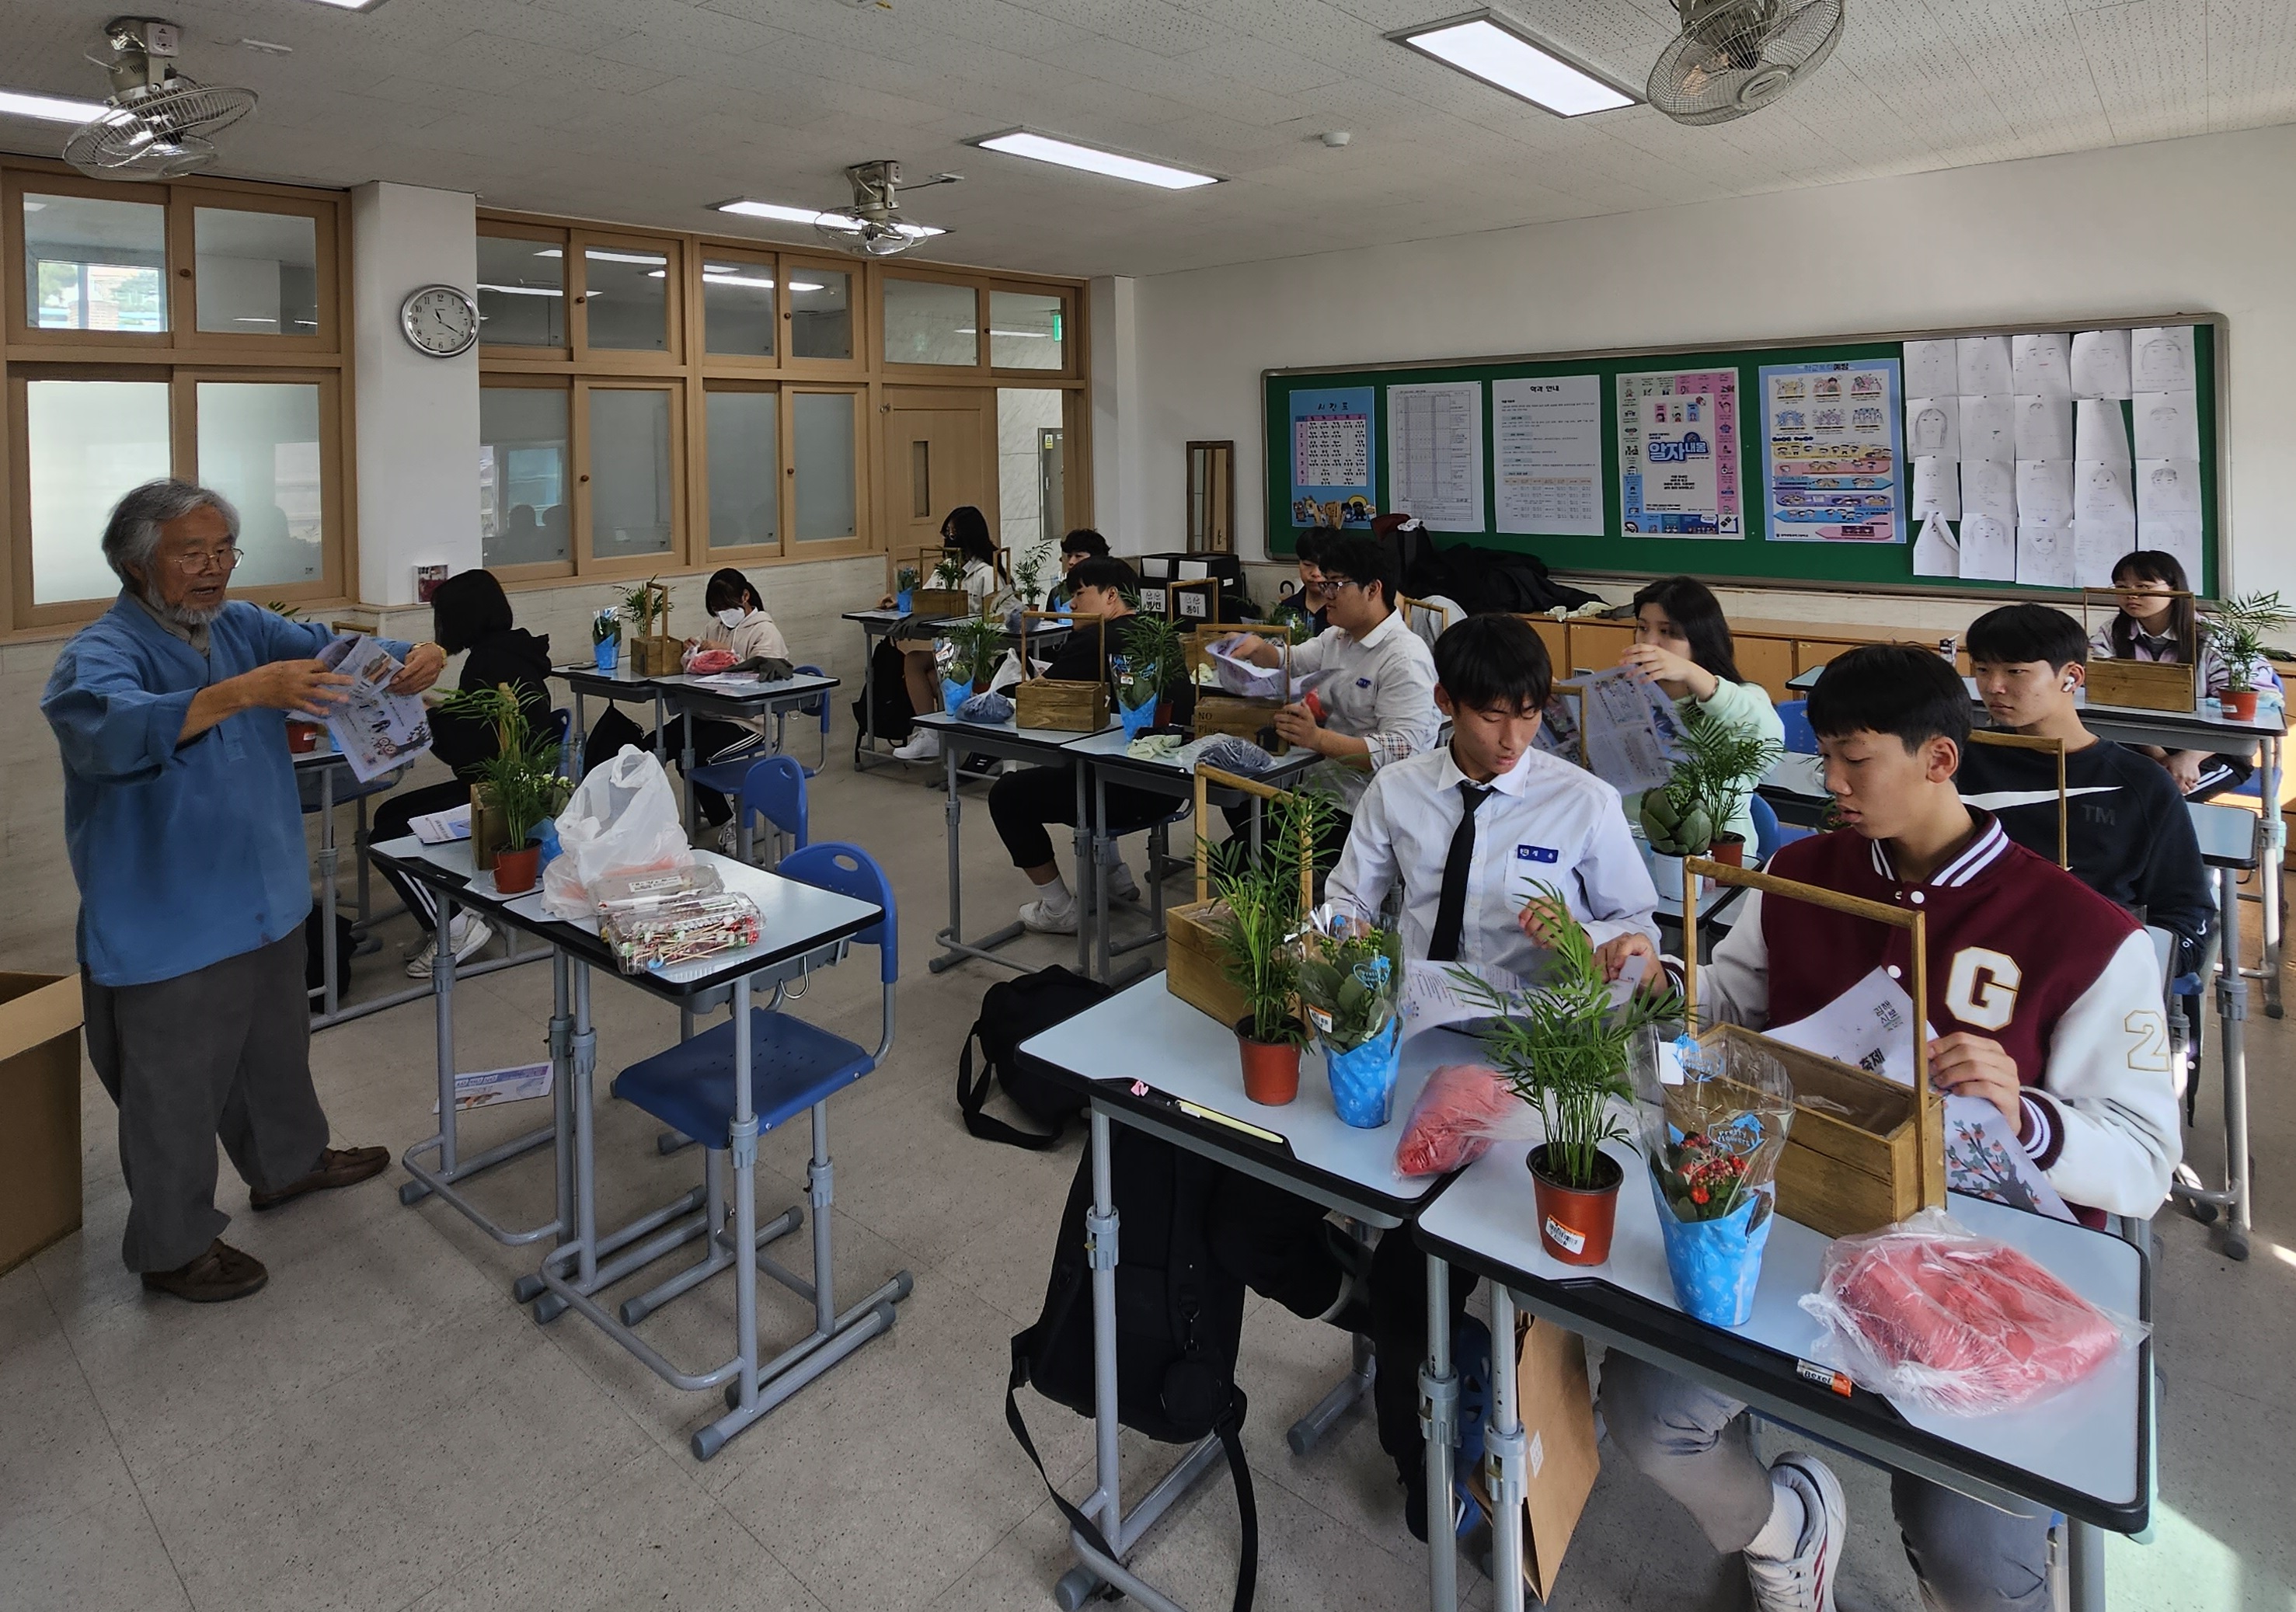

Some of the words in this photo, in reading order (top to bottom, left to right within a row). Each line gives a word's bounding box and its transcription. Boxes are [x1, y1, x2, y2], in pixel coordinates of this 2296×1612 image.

[424, 296, 430, 305] 11
[437, 294, 444, 302] 12
[451, 298, 455, 306] 1
[413, 317, 418, 325] 9
[463, 318, 468, 326] 3
[427, 338, 432, 346] 7
[1649, 443, 1685, 461] 알자
[1685, 442, 1707, 453] 내몸
[1186, 605, 1200, 615] 종이
[1198, 712, 1212, 720] NO
[2082, 805, 2115, 825] TM
[1945, 946, 2023, 1032] G
[1873, 1000, 1891, 1016] 김해
[1880, 1009, 1898, 1023] 시보
[2124, 1010, 2170, 1071] 2
[1804, 1370, 1832, 1384] Bexel
